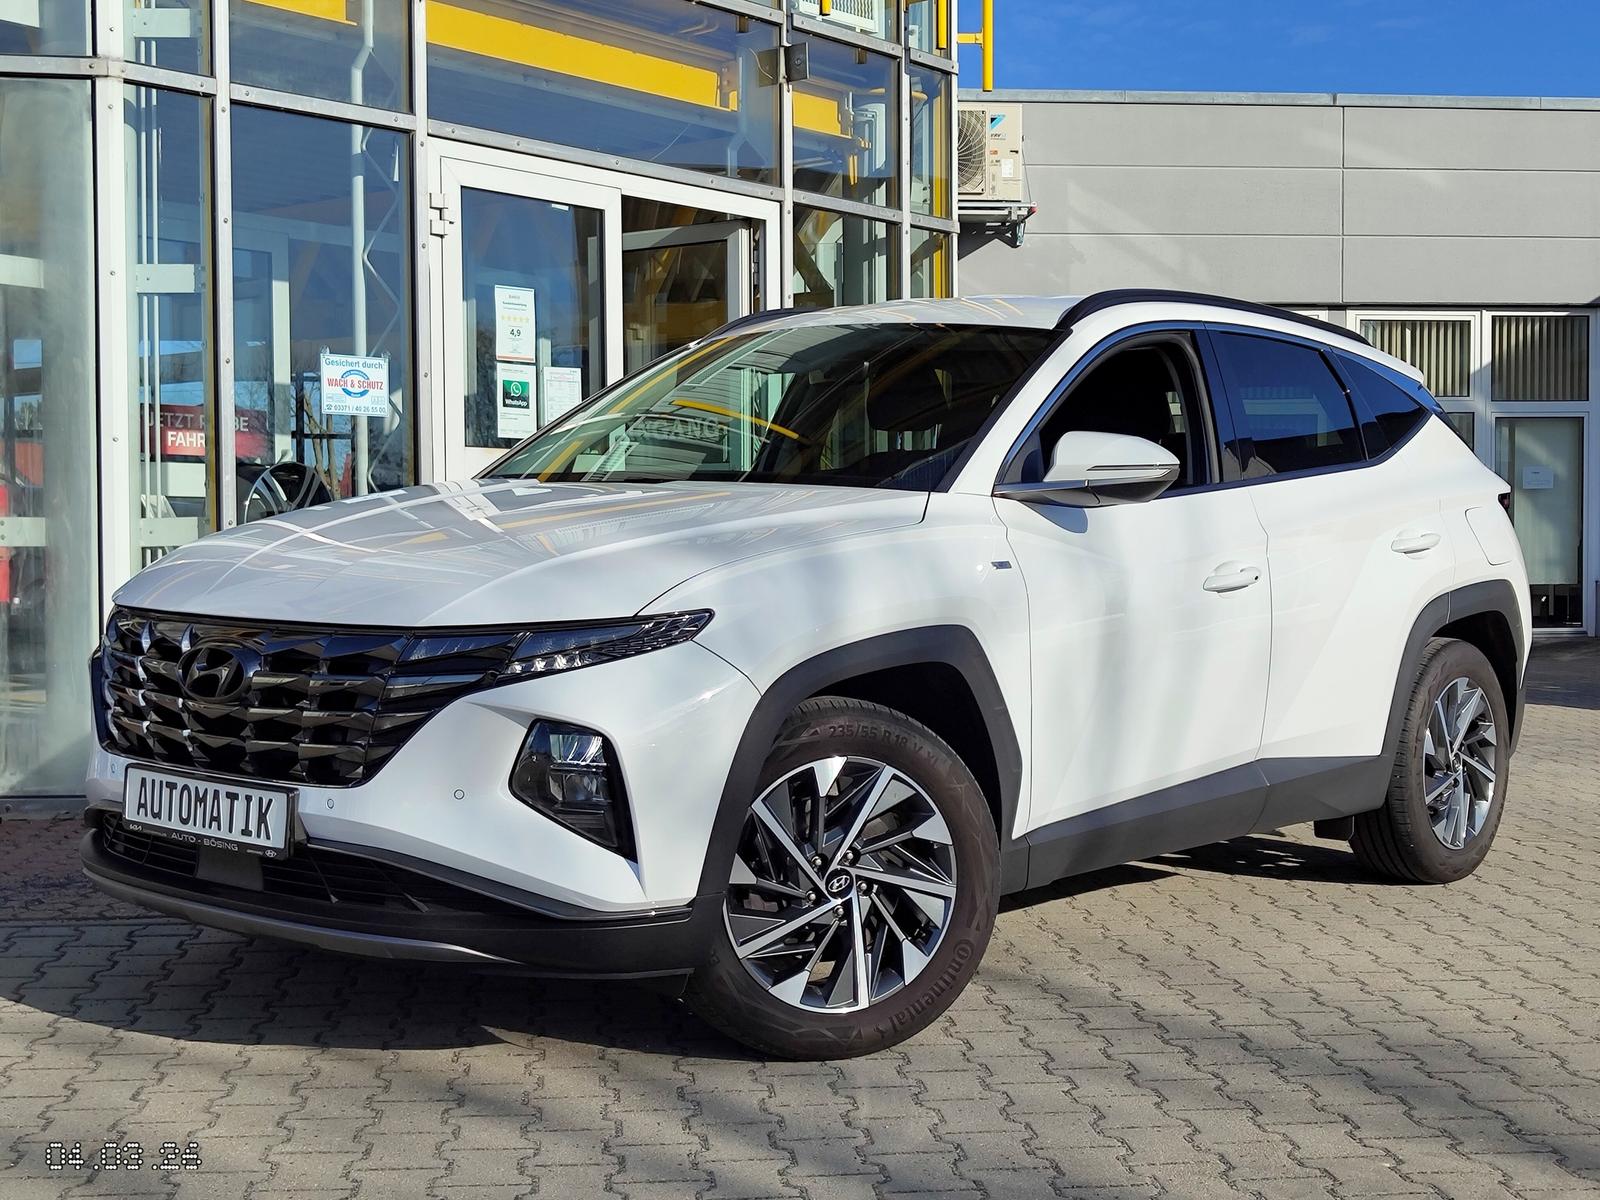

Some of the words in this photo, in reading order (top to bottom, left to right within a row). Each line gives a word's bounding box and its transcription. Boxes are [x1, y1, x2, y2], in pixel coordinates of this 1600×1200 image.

[510, 329, 521, 338] 4,9
[325, 358, 360, 368] Gesichert
[362, 361, 383, 370] durch
[327, 377, 348, 388] WACH
[350, 380, 355, 388] &
[357, 380, 384, 391] SCHUTZ
[505, 399, 528, 407] WhatsApp
[149, 412, 194, 427] JETZT
[199, 414, 249, 432] PBE
[167, 431, 206, 447] FAHR
[828, 723, 877, 739] 235/55
[137, 777, 273, 840] AUTOMATIK
[171, 832, 196, 842] AUTO
[203, 837, 238, 850] BÖSING
[888, 938, 974, 1033] Continental
